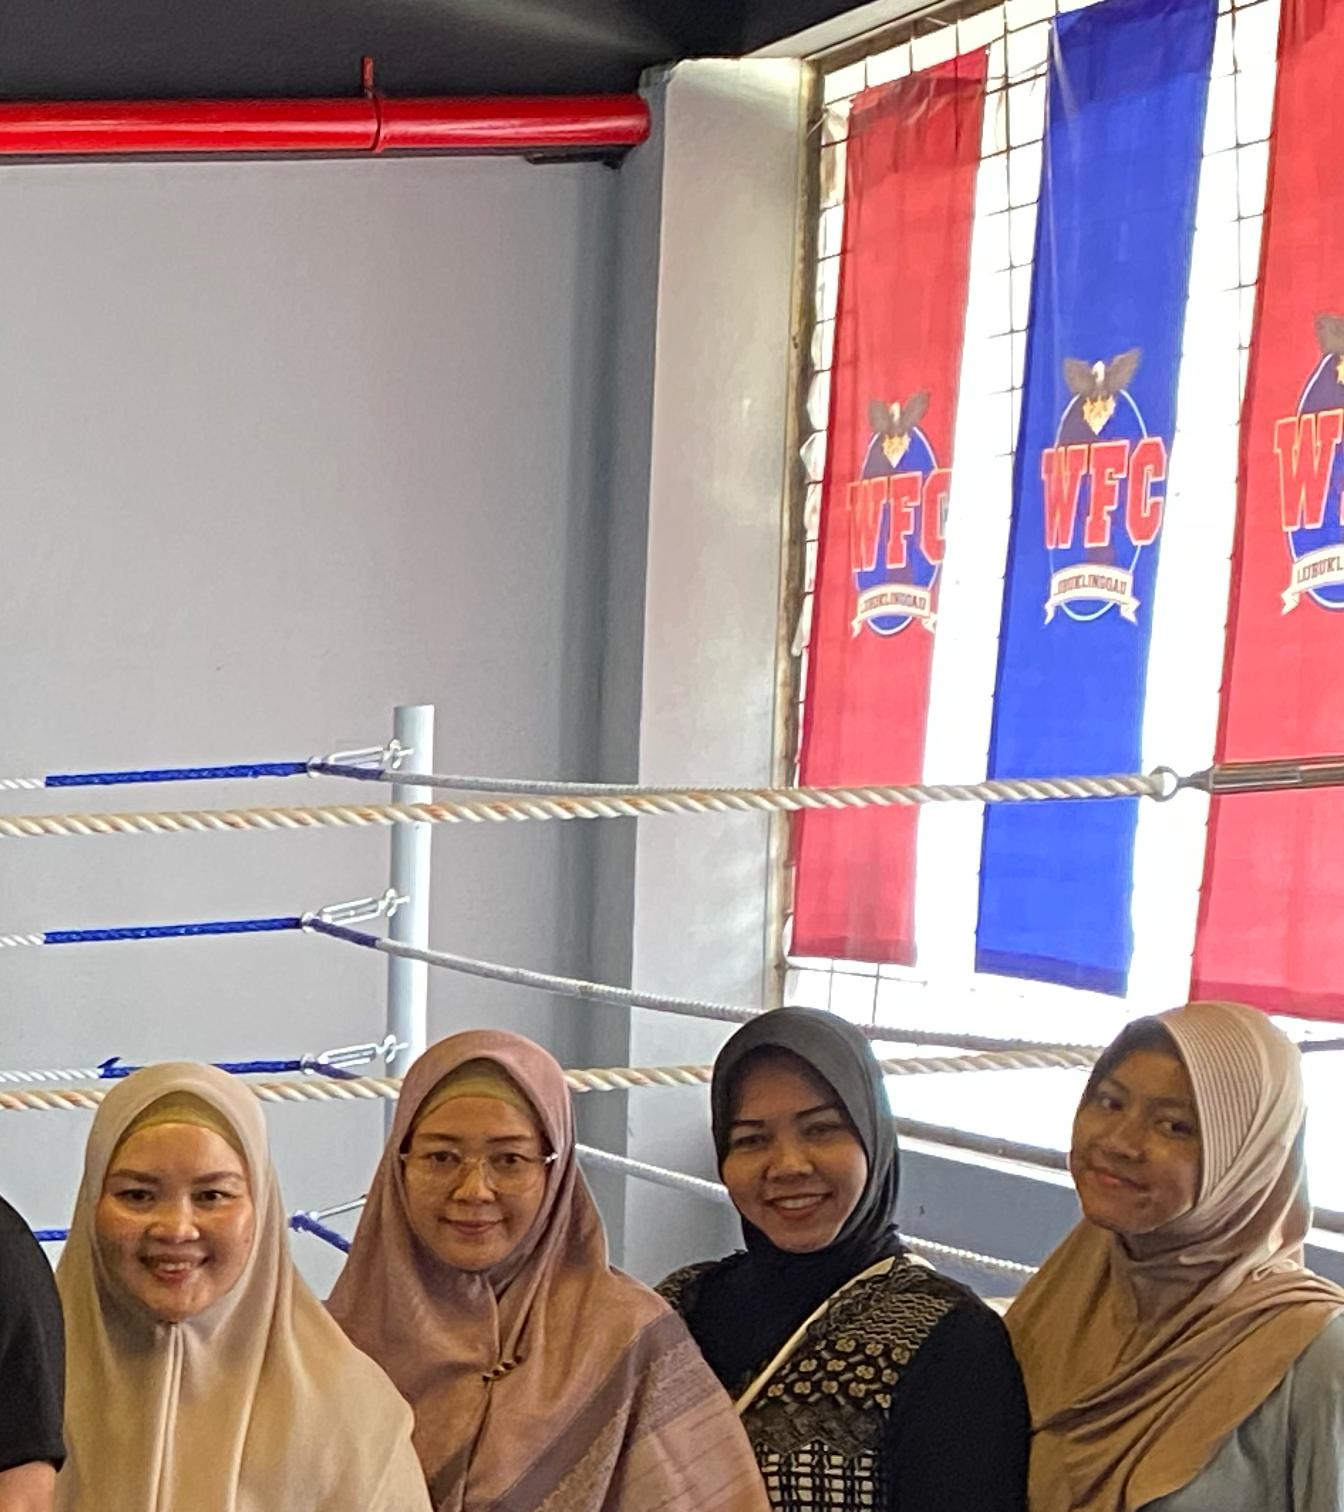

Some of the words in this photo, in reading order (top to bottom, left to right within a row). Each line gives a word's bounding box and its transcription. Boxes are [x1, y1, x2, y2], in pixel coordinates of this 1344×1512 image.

[846, 468, 952, 572] WFC
[1041, 436, 1168, 549] WFC
[1274, 409, 1344, 532] W
